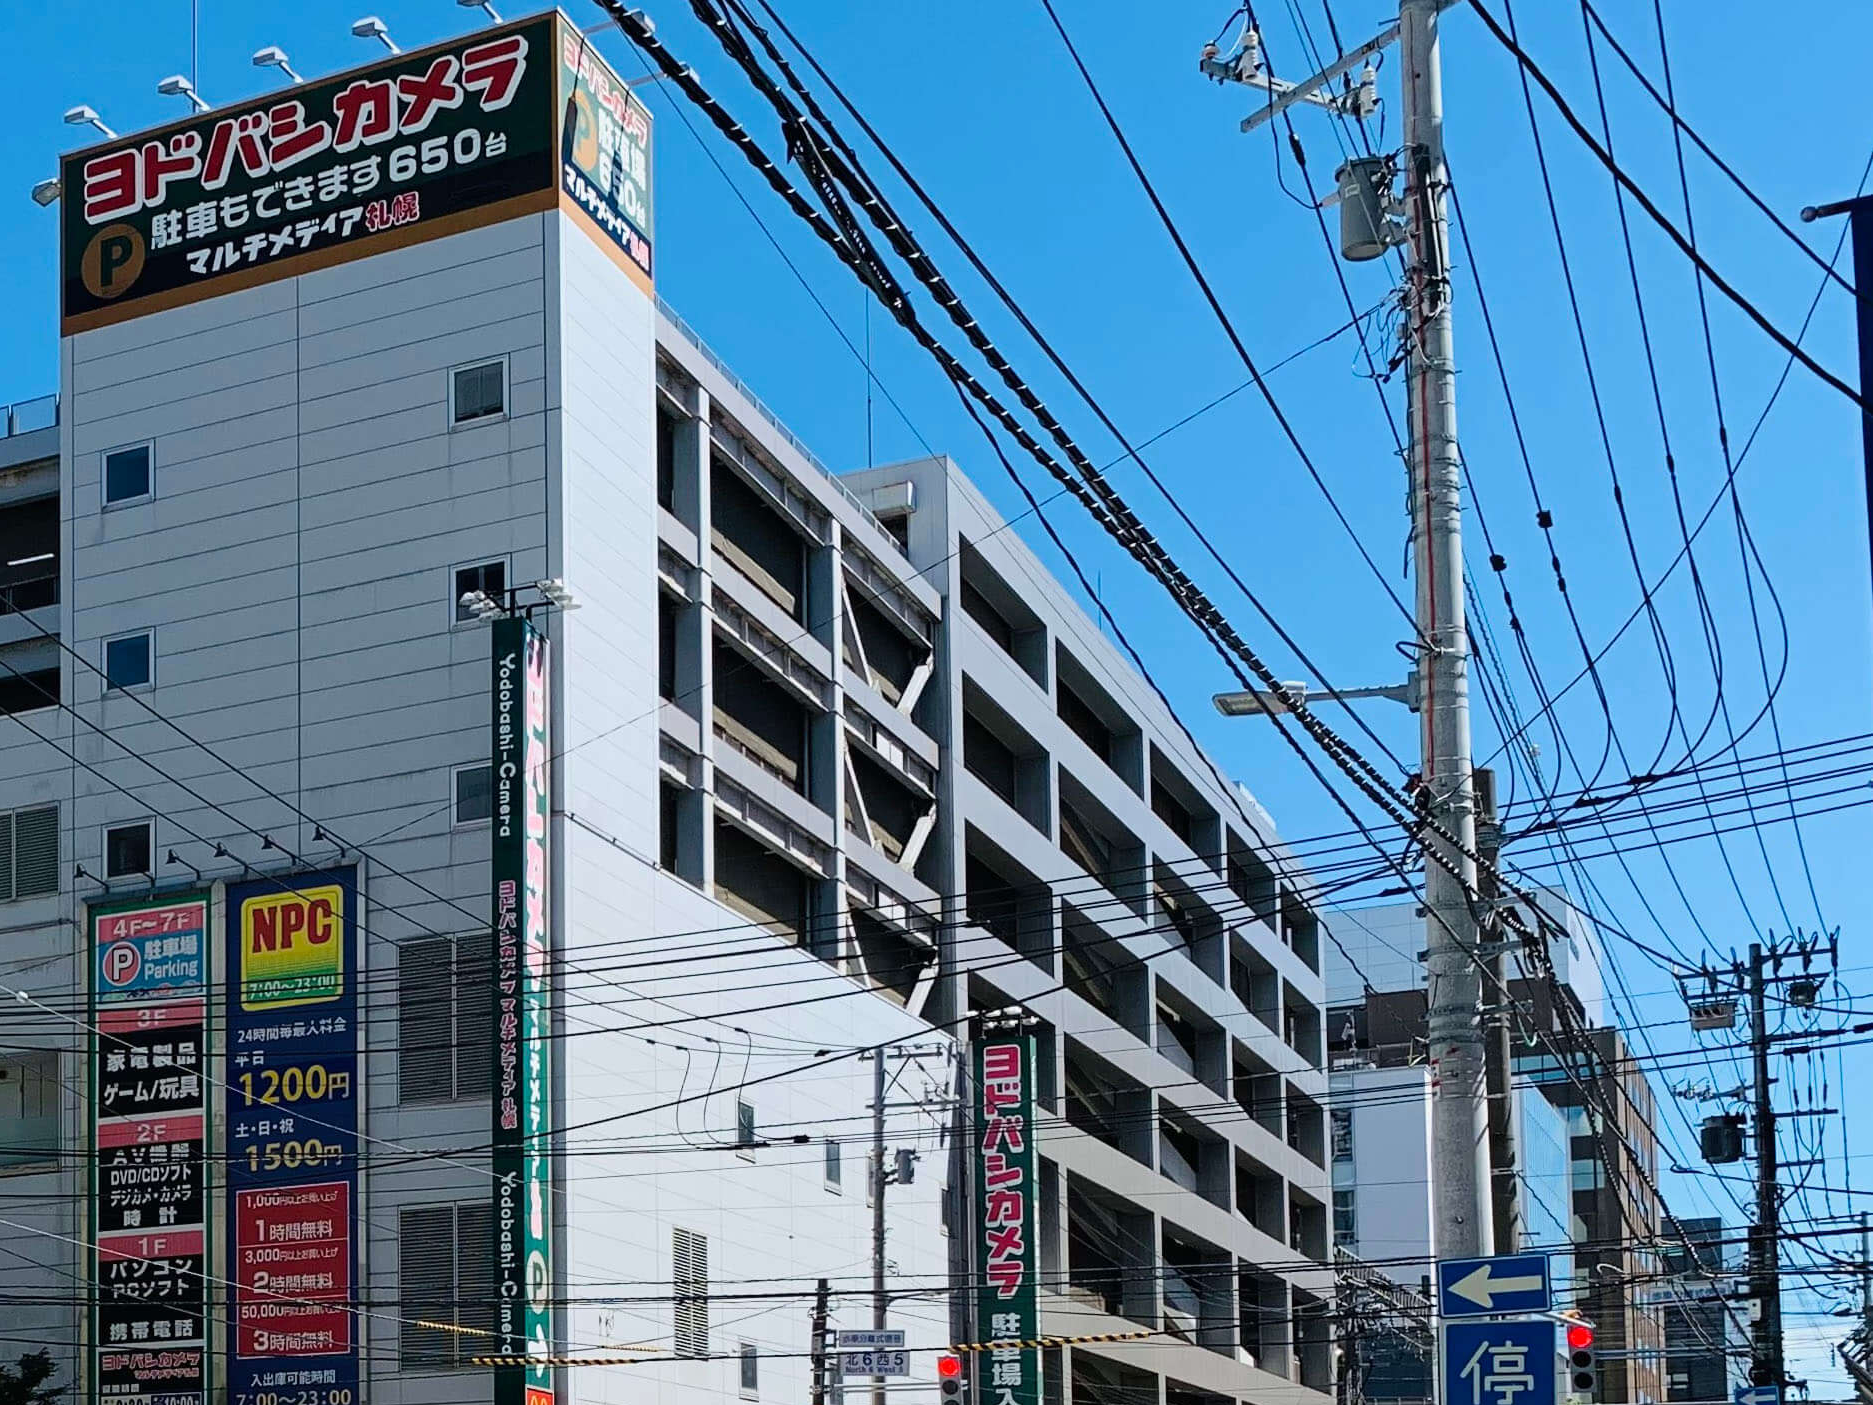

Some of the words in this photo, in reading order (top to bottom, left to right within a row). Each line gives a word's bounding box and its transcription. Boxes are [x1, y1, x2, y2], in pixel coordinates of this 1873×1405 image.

[83, 34, 530, 225] ヨドバシカメラ
[100, 238, 134, 287] P
[499, 653, 516, 837] Yodobashi-Camera
[252, 899, 333, 954] NPC
[112, 946, 135, 982] P
[144, 959, 199, 981] Parking
[239, 1064, 350, 1107] 1200円
[137, 1124, 168, 1144] 2F
[245, 1139, 343, 1173] 1500円
[111, 1164, 192, 1186] DVD/CDソフト
[982, 1044, 1024, 1300] ヨドバシカメラ
[255, 1219, 333, 1242] 1時間無料
[137, 1237, 168, 1256] 1F
[110, 1258, 193, 1280] パソコン
[253, 1271, 333, 1294] 2時間無料
[109, 1319, 193, 1342] 携帯電話
[253, 1330, 333, 1352] 3時間無料
[102, 1352, 201, 1371] ヨドバシカメラ
[1460, 1340, 1535, 1405] 停
